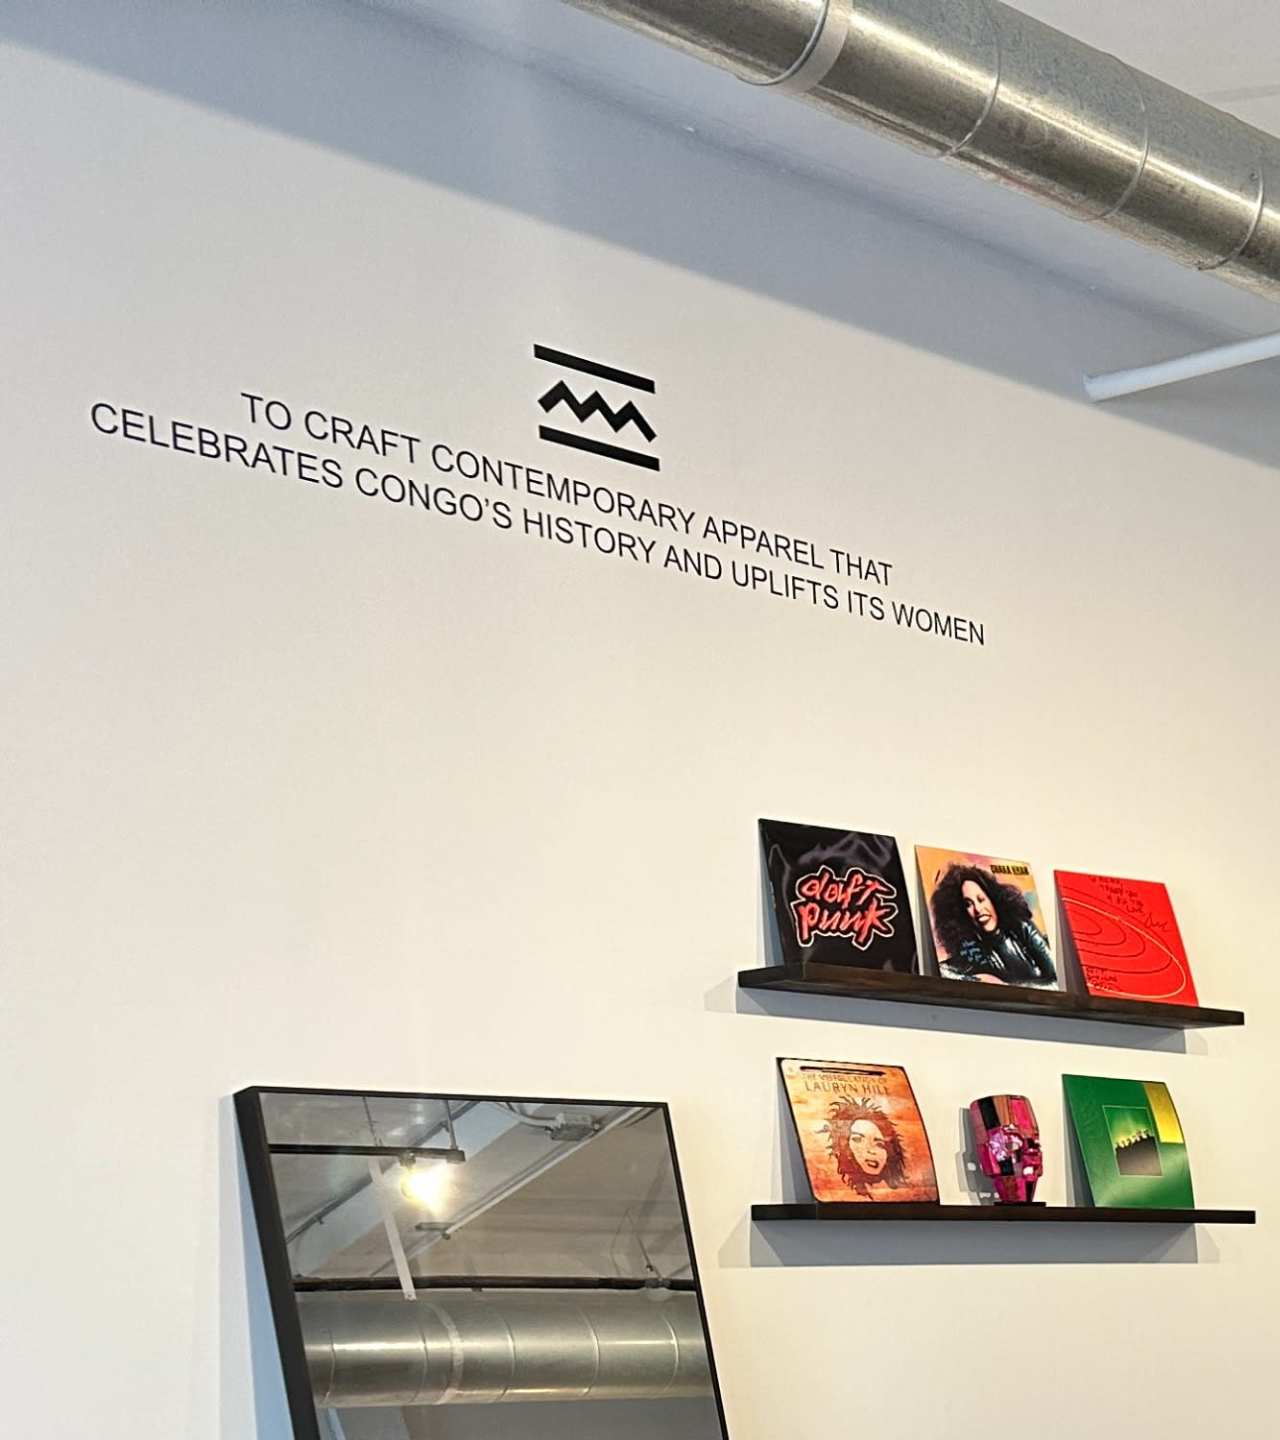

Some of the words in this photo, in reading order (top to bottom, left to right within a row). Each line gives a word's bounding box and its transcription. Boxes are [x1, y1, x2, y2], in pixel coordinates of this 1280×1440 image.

[91, 402, 343, 489] CELEBRATES
[355, 467, 512, 529] CONGO'S
[523, 508, 657, 564] HISTORY
[663, 545, 722, 580] AND
[731, 560, 839, 610] UPLIFTS
[847, 590, 885, 621] ITS
[891, 601, 985, 646] WOMEN
[240, 392, 292, 431] TO
[304, 410, 421, 464] CRAFT
[431, 444, 696, 535] CONTEMPORARY
[702, 516, 826, 570] APPAREL
[829, 548, 893, 586] THAT
